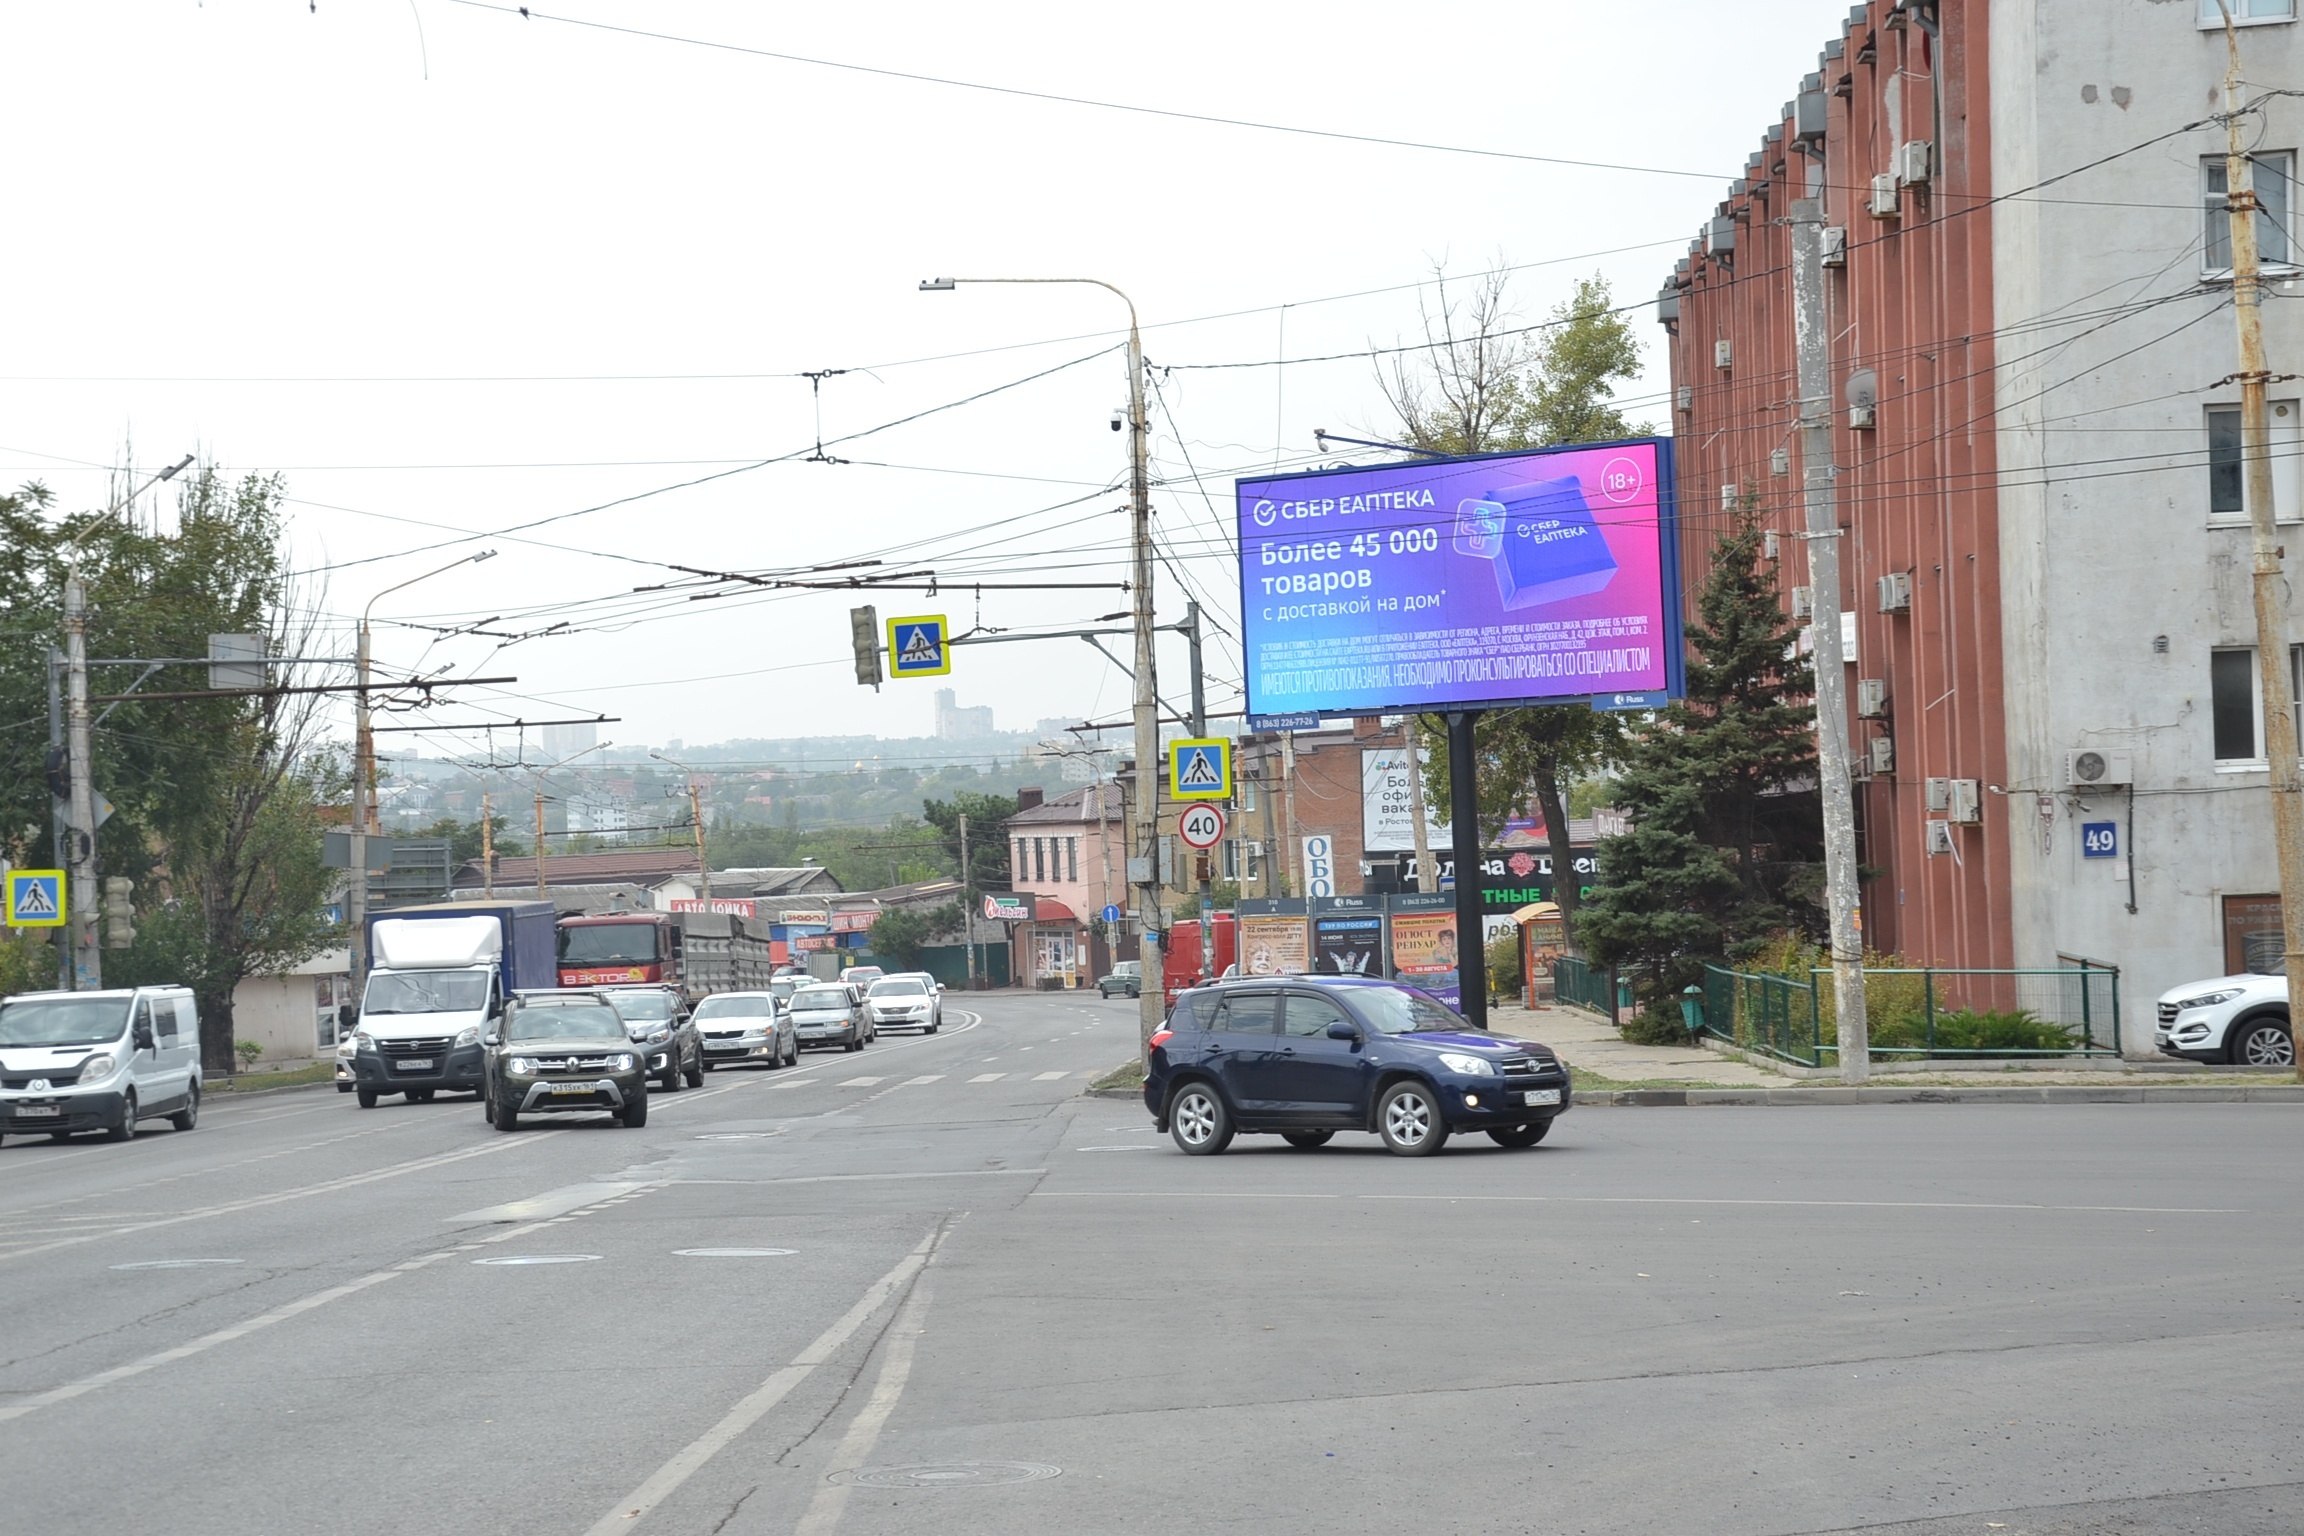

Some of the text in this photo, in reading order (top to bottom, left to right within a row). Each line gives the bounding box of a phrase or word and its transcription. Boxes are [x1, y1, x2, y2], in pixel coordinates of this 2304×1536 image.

[1607, 473, 1636, 489] 18+
[1281, 489, 1435, 519] СБЕР ЕАПТЕКА
[1531, 520, 1560, 533] СБЕР
[1534, 525, 1588, 545] ЕАПТЕКА
[1261, 528, 1438, 566] Более 45 000
[1260, 569, 1372, 595] товаров
[1263, 608, 1273, 621] с
[1277, 596, 1371, 622] доставкой
[1377, 596, 1398, 611] на
[1261, 647, 1651, 696] ИМЕЮТСЯ ПРОТИВОПОКАЗАНИЯ. НЕОБХОДИМО ПРОКОНСУЛЬТИРОВАТЬСЯ СО СПЕЦИАЛИСТОМ
[1626, 695, 1645, 703] Russ
[1256, 716, 1314, 729] 8 (863) 226-77-26
[1187, 816, 1215, 835] 40
[2085, 829, 2114, 851] 49
[1481, 888, 1541, 904] ТНЫЕ
[1257, 925, 1289, 933] сентября
[1396, 929, 1433, 939] ОГЮСТ
[1396, 940, 1437, 950] РЕНУАР
[563, 973, 630, 985] ВЕКТОР
